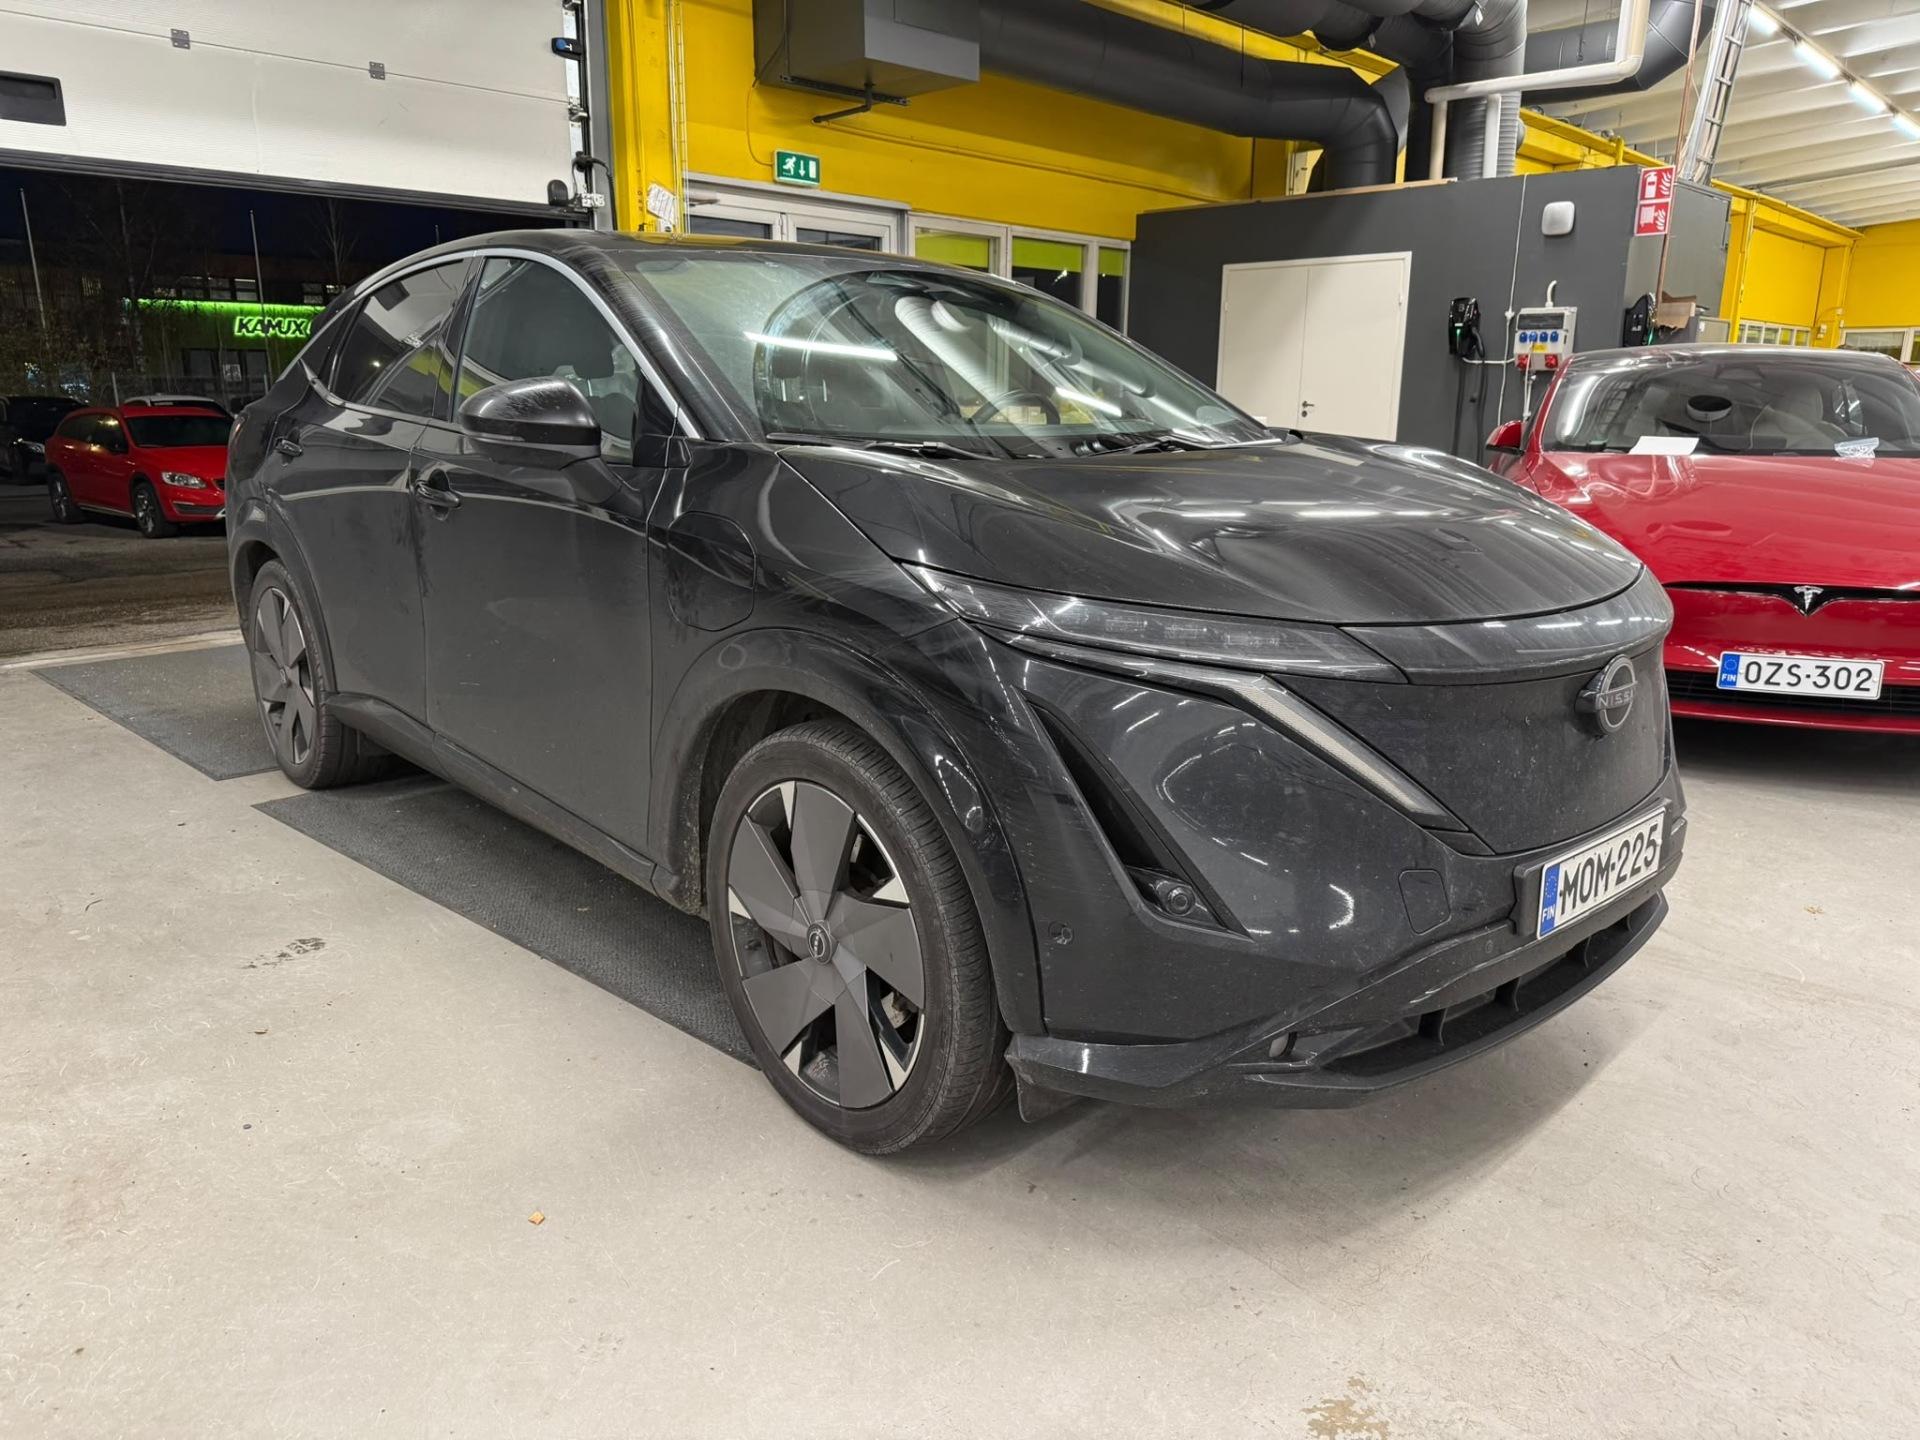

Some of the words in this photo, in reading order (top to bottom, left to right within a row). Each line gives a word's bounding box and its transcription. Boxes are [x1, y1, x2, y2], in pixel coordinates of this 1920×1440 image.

[235, 316, 307, 337] KAMUX
[1721, 673, 1737, 683] FIN
[1744, 661, 1873, 692] OZS-302
[1542, 904, 1555, 923] FIN
[1560, 823, 1658, 916] MOM-225
